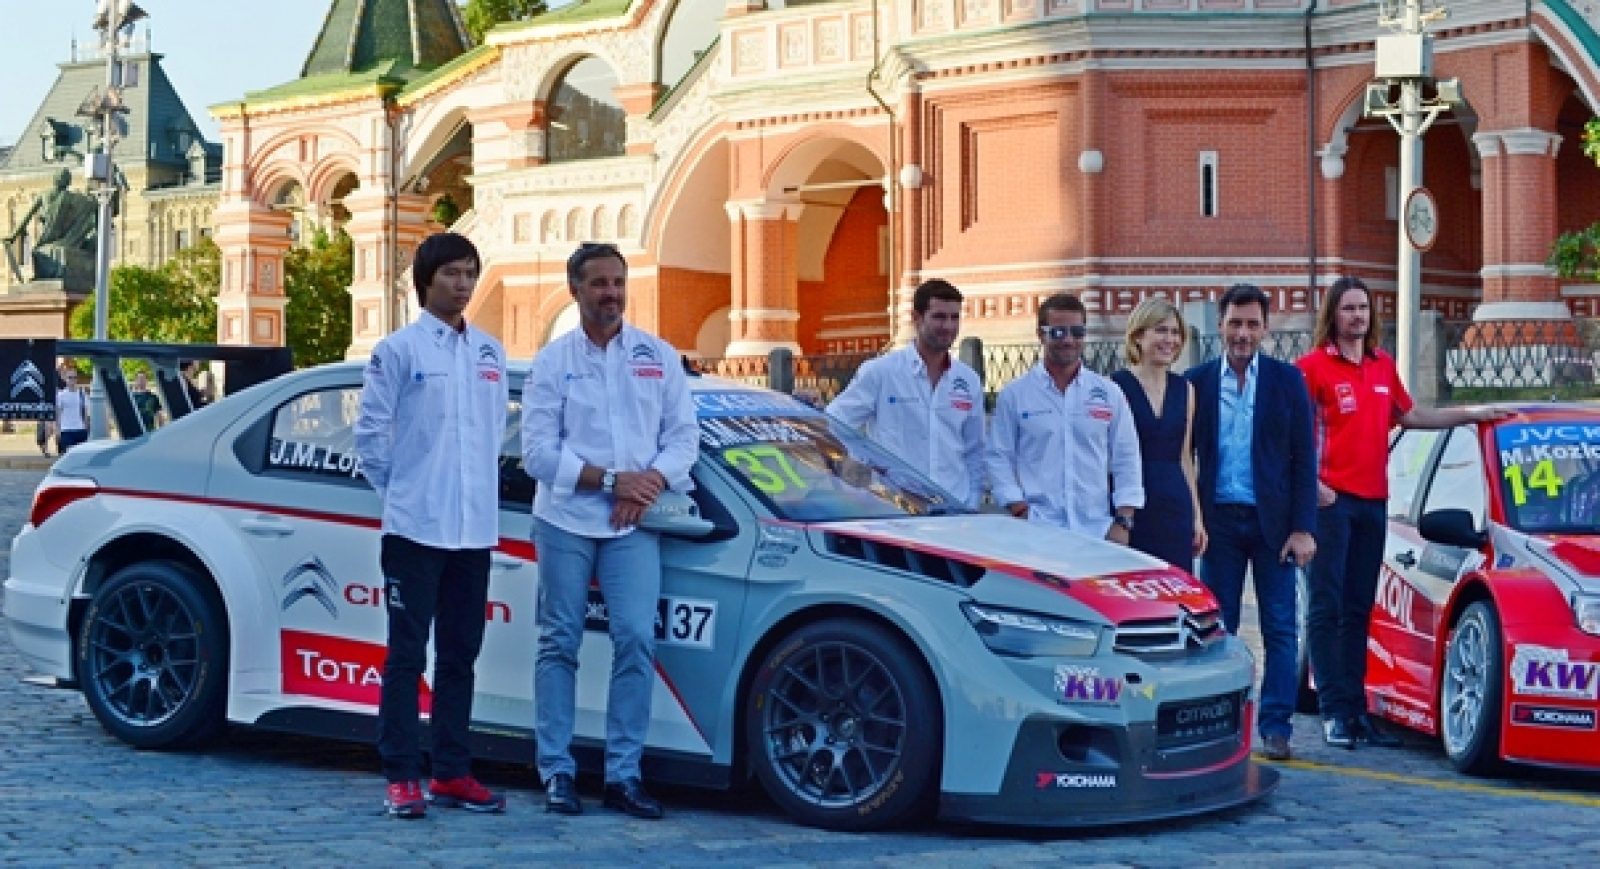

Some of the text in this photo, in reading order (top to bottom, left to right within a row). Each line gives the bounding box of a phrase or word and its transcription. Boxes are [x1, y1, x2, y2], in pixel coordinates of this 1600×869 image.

[1512, 426, 1579, 443] JVC
[724, 445, 808, 493] 37
[1504, 458, 1563, 506] 14
[673, 603, 713, 641] 37
[296, 648, 383, 687] TOTA
[1525, 660, 1596, 690] KW
[1064, 673, 1123, 701] KW
[1056, 774, 1117, 788] YOKOHAMA
